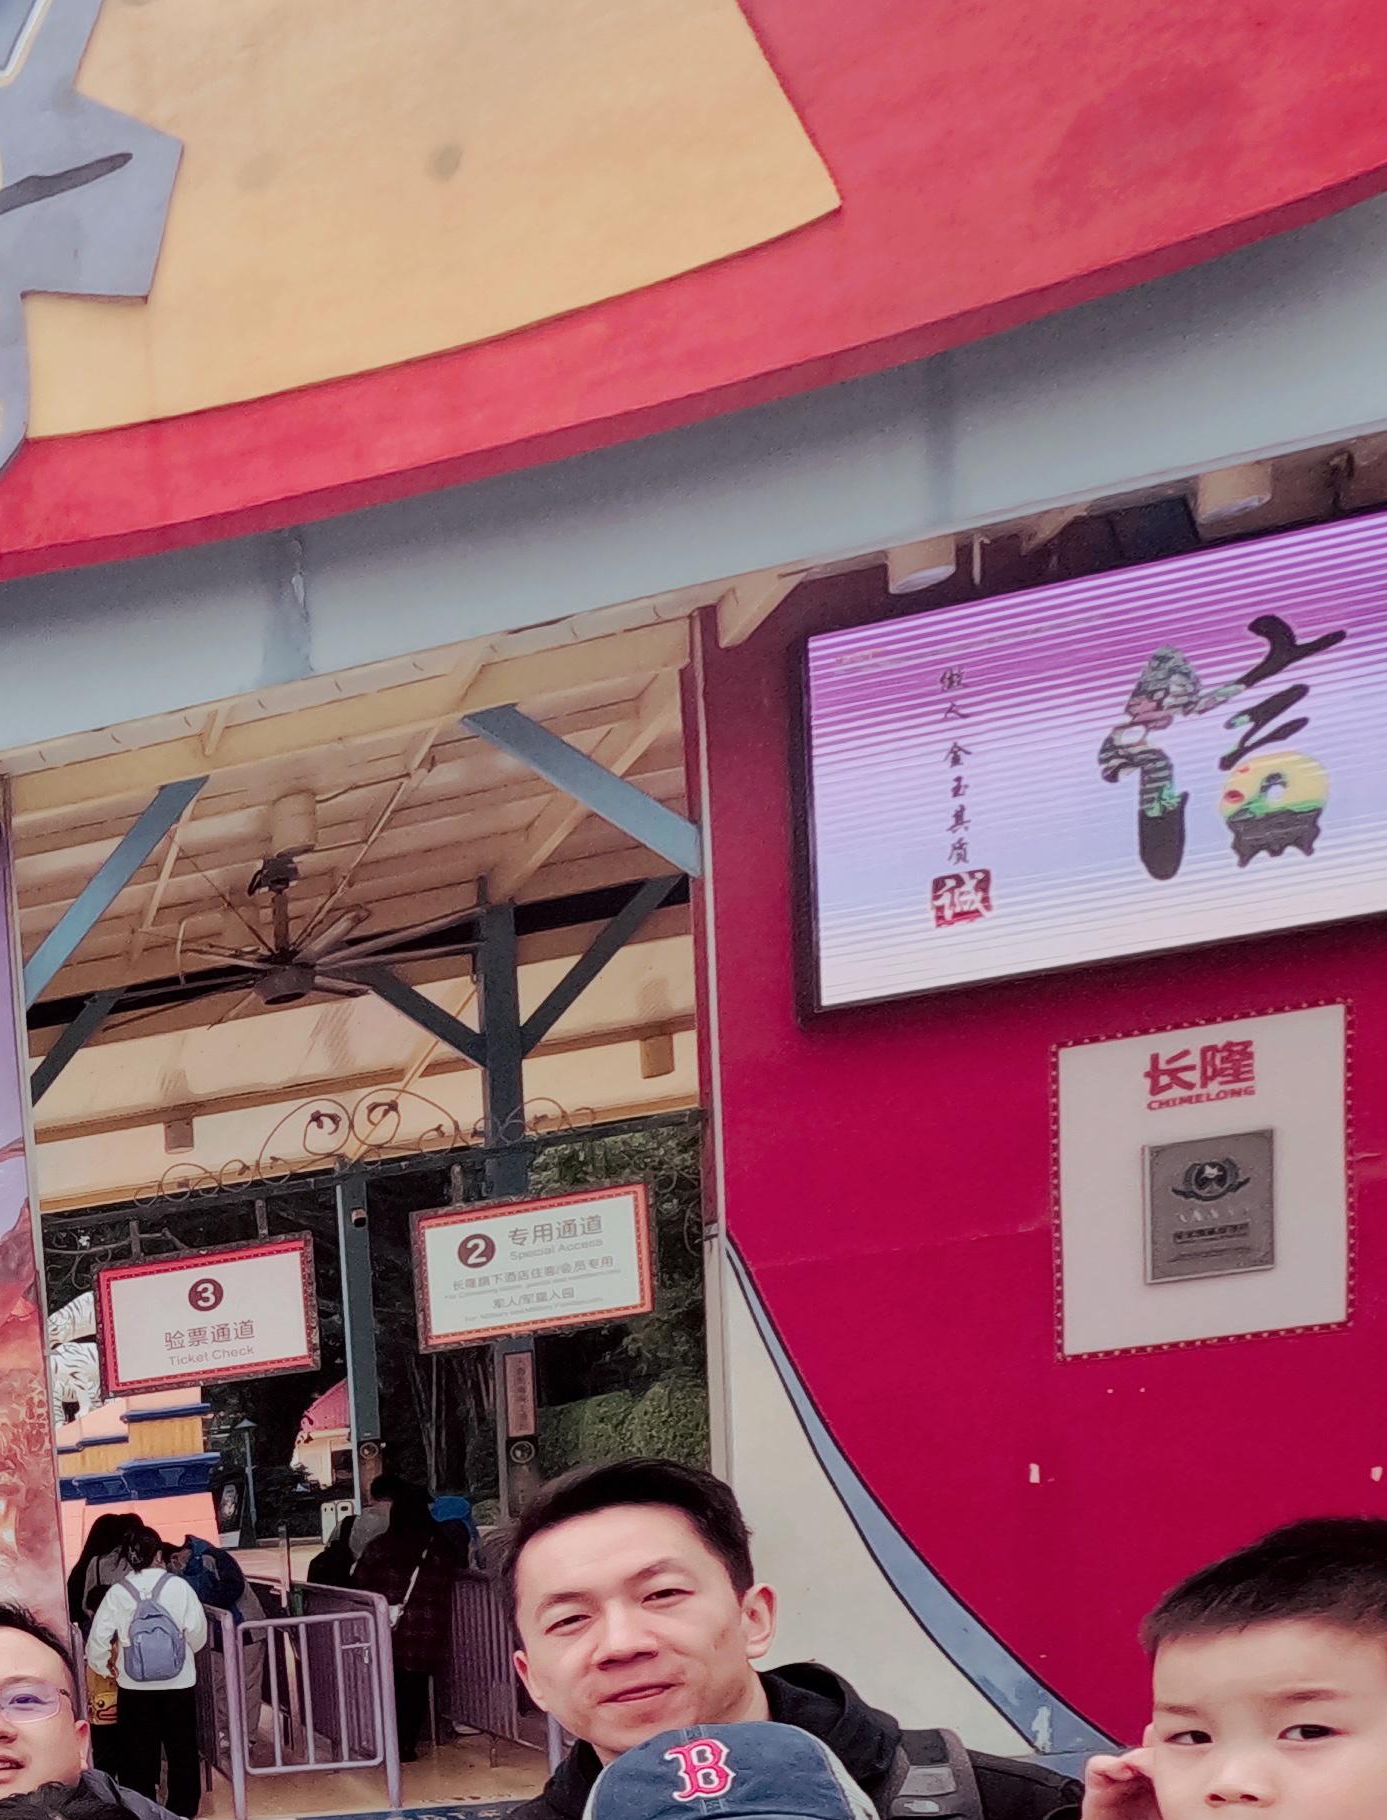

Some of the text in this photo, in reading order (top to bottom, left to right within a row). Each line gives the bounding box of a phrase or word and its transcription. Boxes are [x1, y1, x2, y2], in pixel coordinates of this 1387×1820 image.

[1144, 1040, 1255, 1096] 长隆
[1146, 1085, 1256, 1111] CHIMELONG
[508, 1214, 603, 1247] 专用通道
[463, 1236, 490, 1267] 2
[193, 1281, 218, 1309] 3
[164, 1319, 255, 1351] 验票通道
[169, 1345, 255, 1366] Ticket Check
[664, 1738, 736, 1801] B
